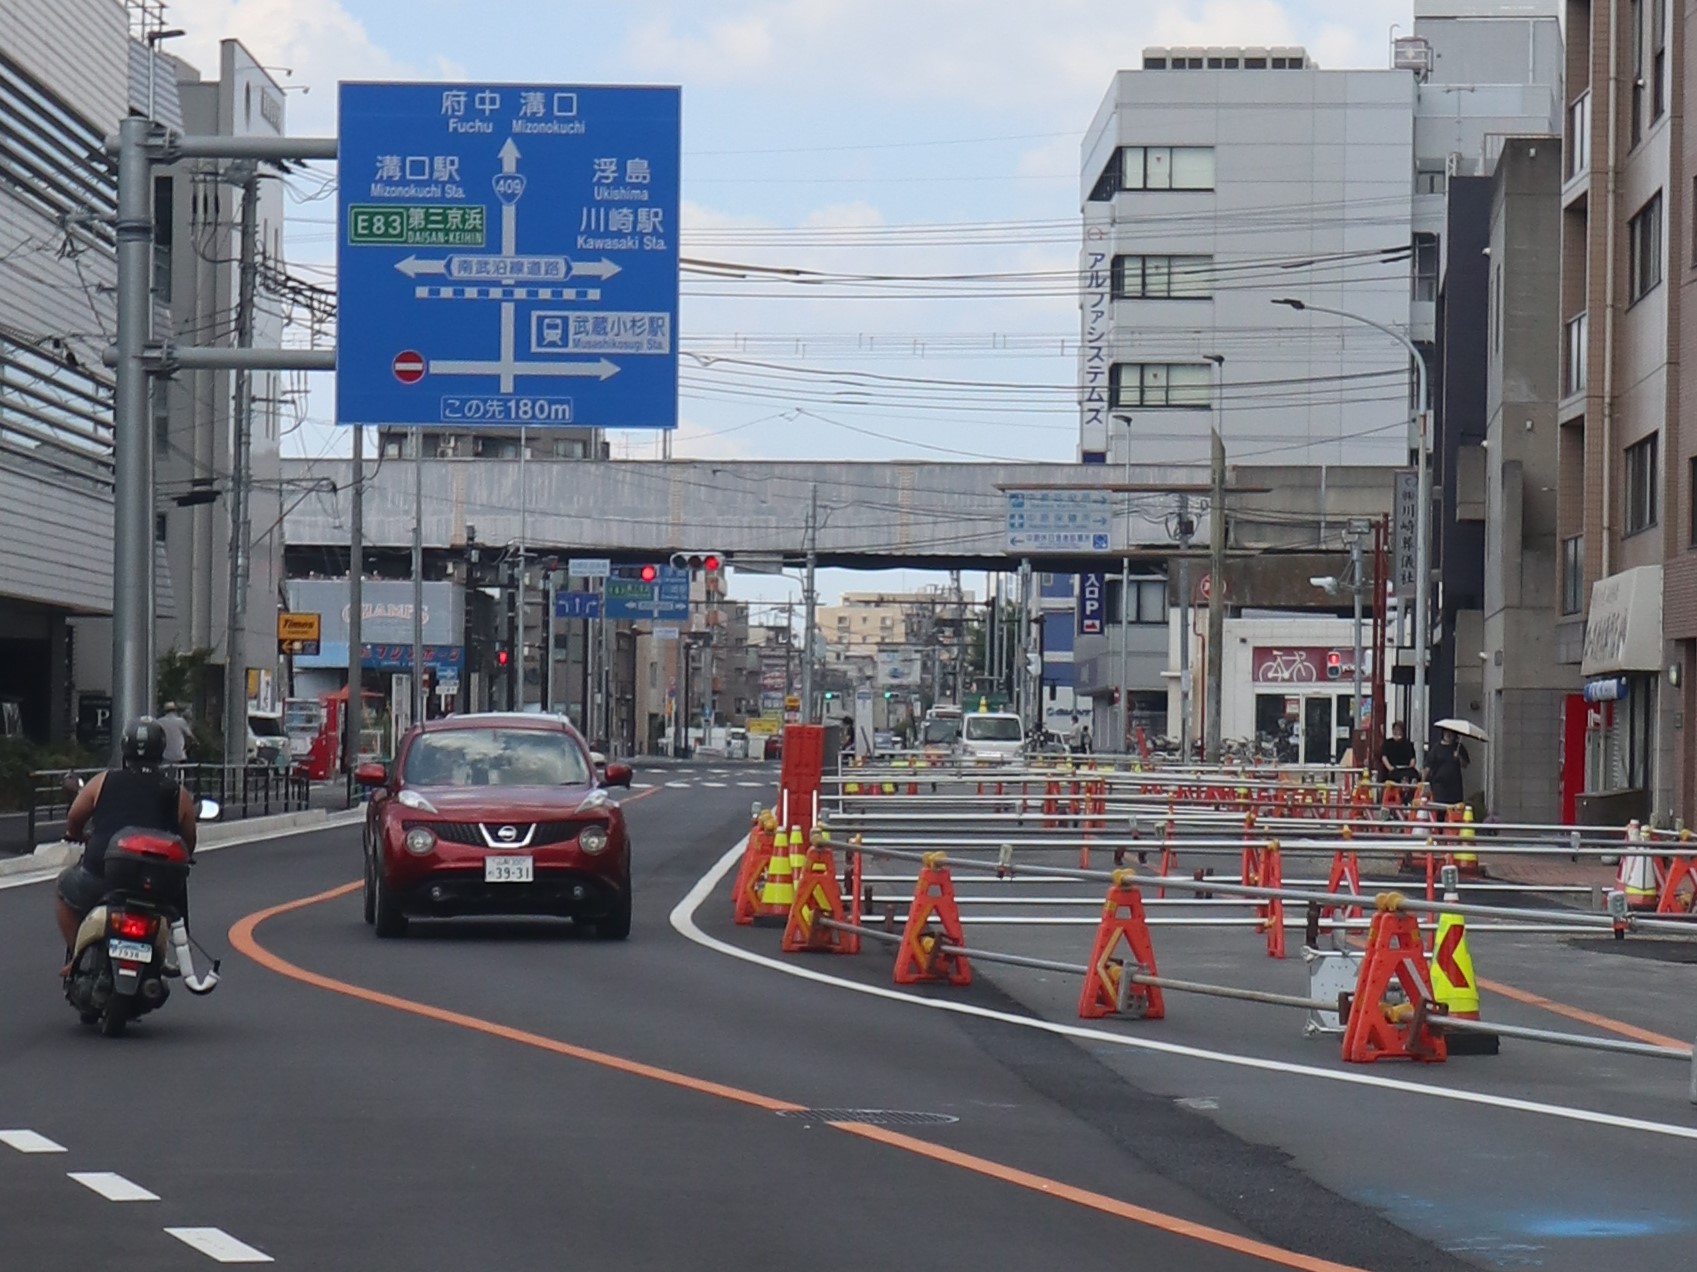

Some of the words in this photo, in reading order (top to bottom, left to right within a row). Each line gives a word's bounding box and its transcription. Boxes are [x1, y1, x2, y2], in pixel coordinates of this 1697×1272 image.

[441, 90, 500, 117] 府中
[519, 92, 577, 117] 溝口
[449, 119, 493, 134] Fuchu
[512, 119, 586, 134] Mizonokuchi
[375, 155, 460, 181] 溝口駅
[592, 157, 650, 184] 浮島
[370, 183, 442, 198] Mizonokuchi
[445, 184, 466, 199] Sta.
[496, 178, 522, 194] 409
[594, 186, 649, 201] Ukishima
[357, 215, 401, 235] E83
[408, 207, 484, 231] 第三京浜
[579, 207, 664, 234] 川崎駅
[577, 235, 639, 250] Kawasaki
[642, 236, 667, 250] Sta.
[457, 260, 562, 276] 南武沿線道路
[573, 316, 666, 338] 武蔵小杉駅
[1086, 252, 1106, 425] アルファシステムズ
[445, 400, 570, 420] この先180m
[283, 619, 316, 629] Times
